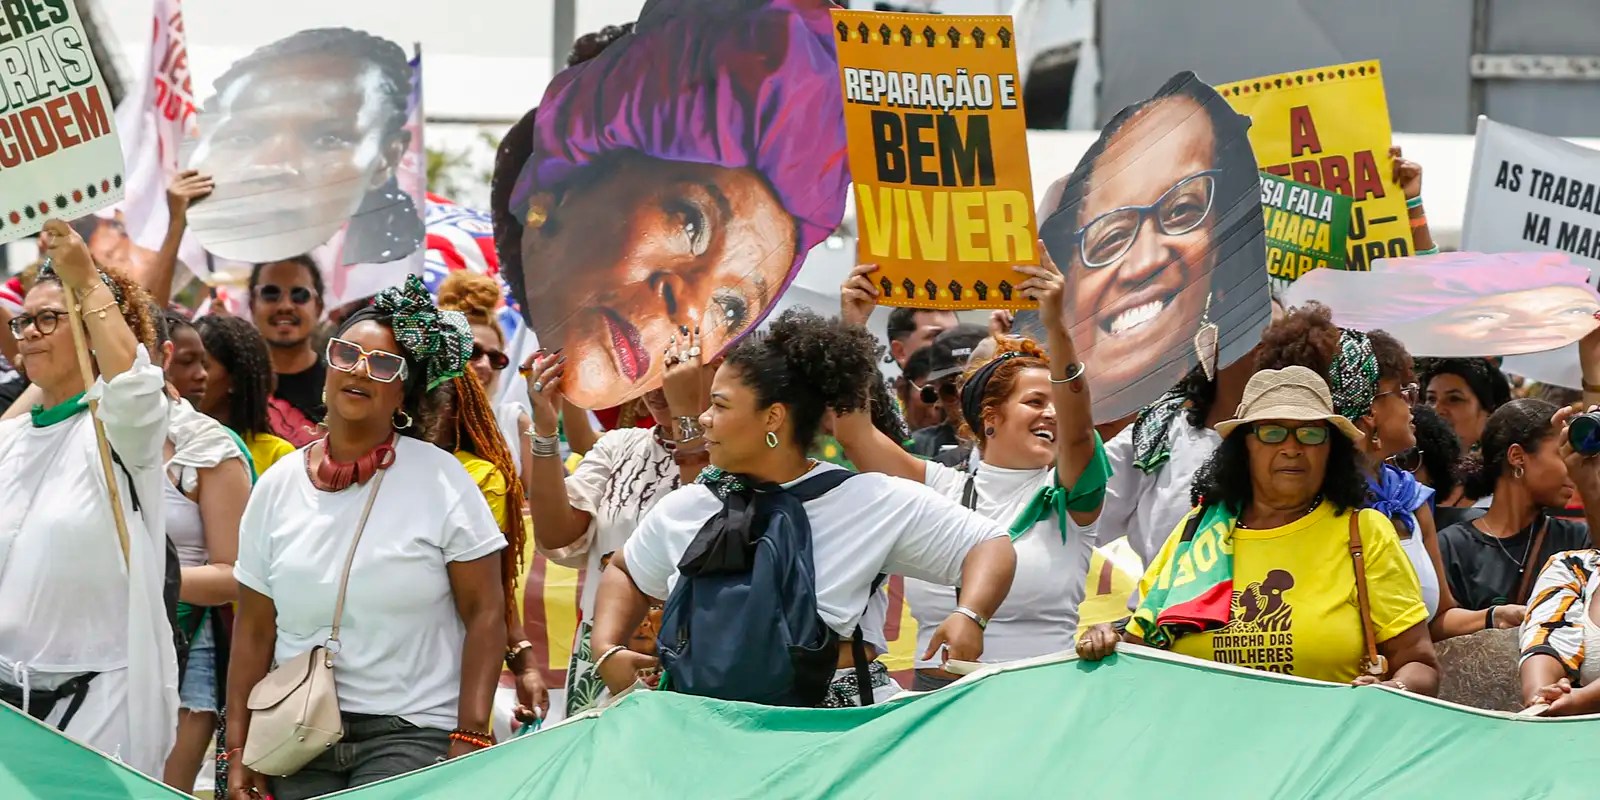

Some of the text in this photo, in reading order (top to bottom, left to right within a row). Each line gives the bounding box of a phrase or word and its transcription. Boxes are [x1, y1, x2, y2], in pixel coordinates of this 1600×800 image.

[0, 26, 93, 113] RAS
[844, 67, 1018, 112] REPARAÇÃO E
[871, 110, 996, 187] BEM
[1290, 105, 1322, 157] A
[1494, 160, 1523, 192] AS
[1259, 176, 1333, 222] SA FALA
[857, 184, 1033, 262] VIVER
[1522, 211, 1552, 246] NA
[1213, 633, 1293, 648] MARCHA DAS
[1213, 647, 1294, 664] MULHERES
